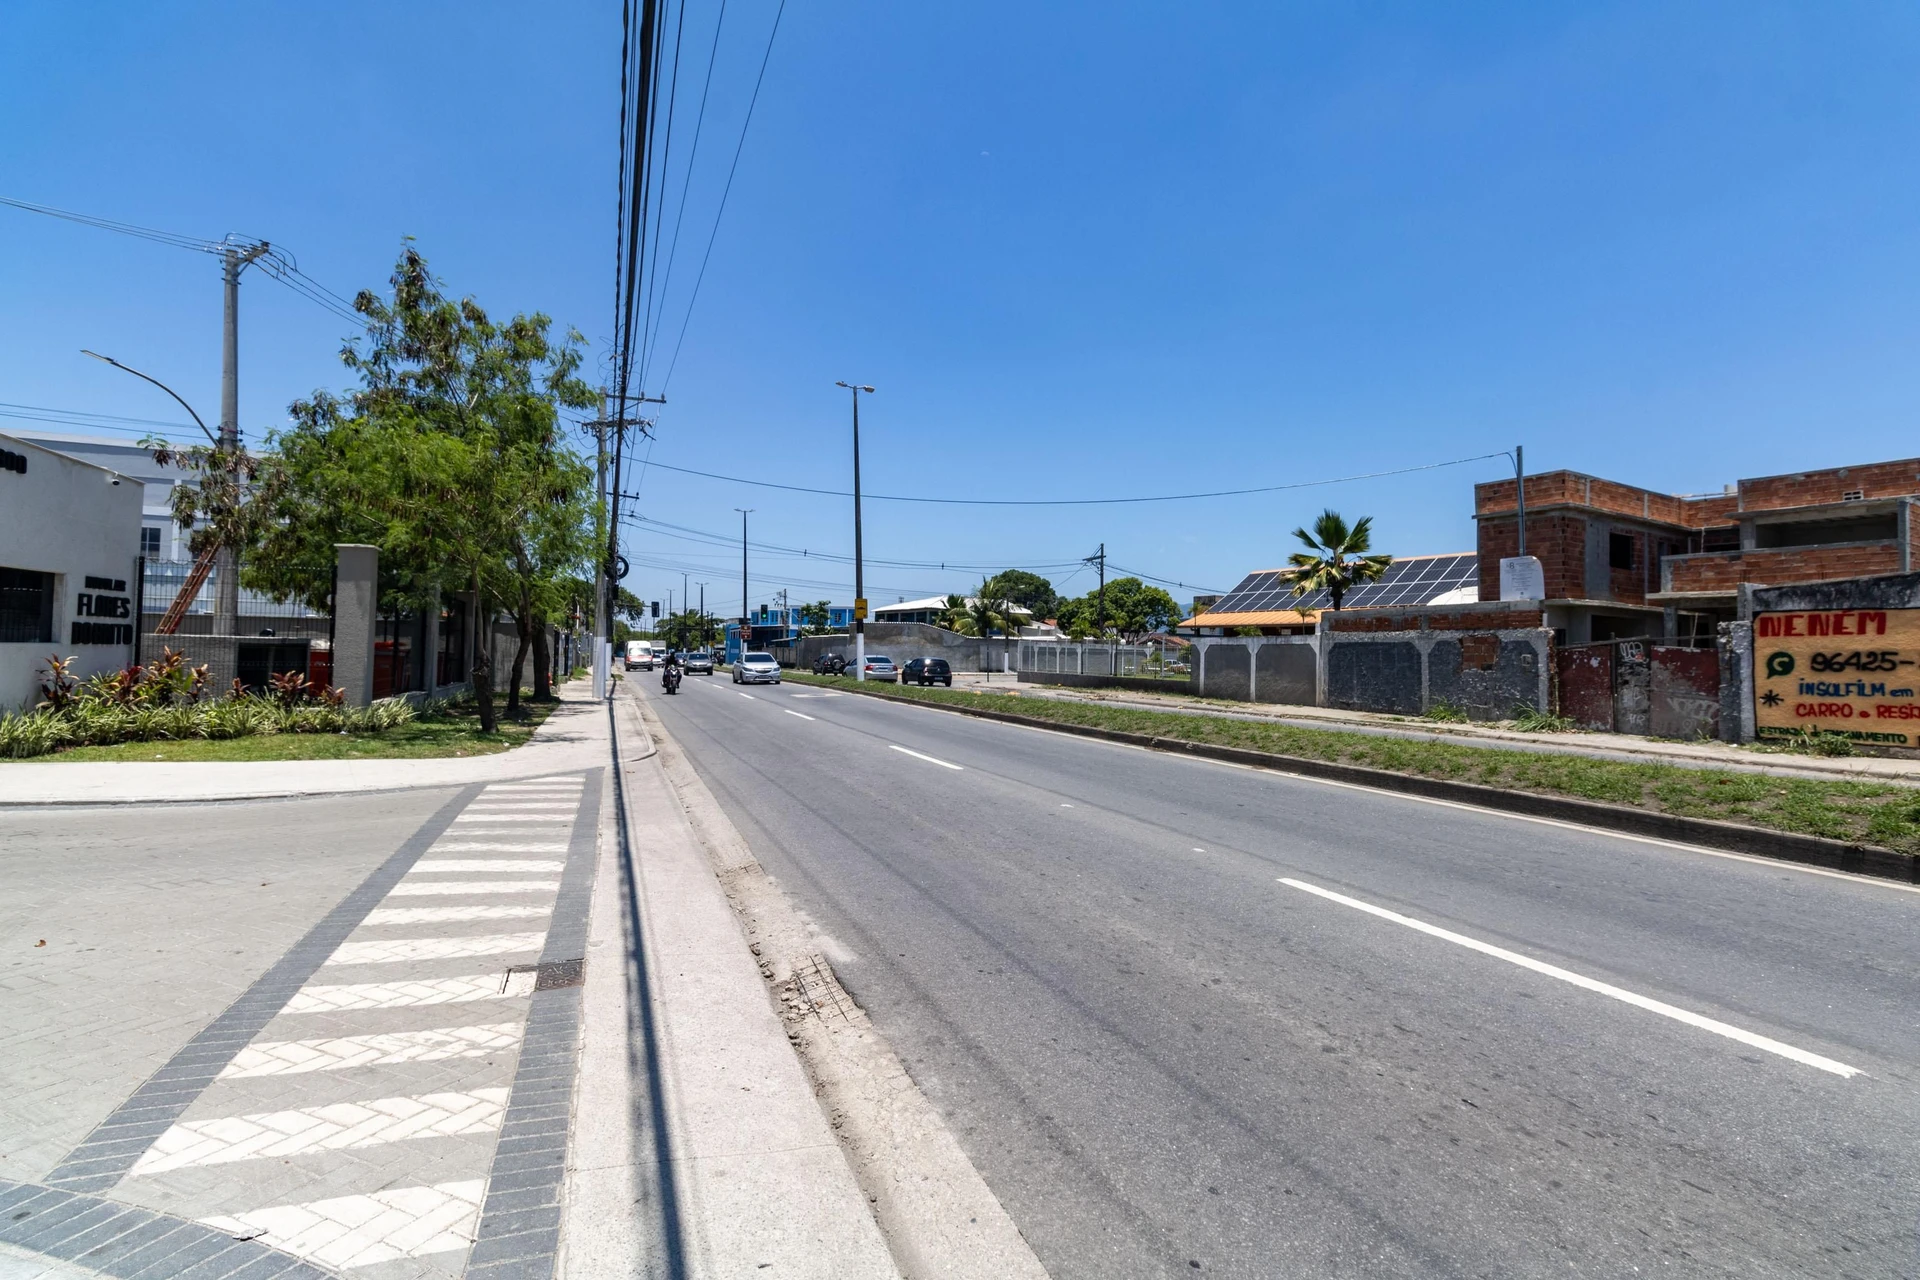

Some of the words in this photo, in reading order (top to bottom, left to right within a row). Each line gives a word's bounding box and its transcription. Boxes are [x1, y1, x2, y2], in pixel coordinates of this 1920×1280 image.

[1810, 651, 1920, 672] 96425-
[1889, 688, 1914, 697] em
[1796, 703, 1853, 718] CARRO
